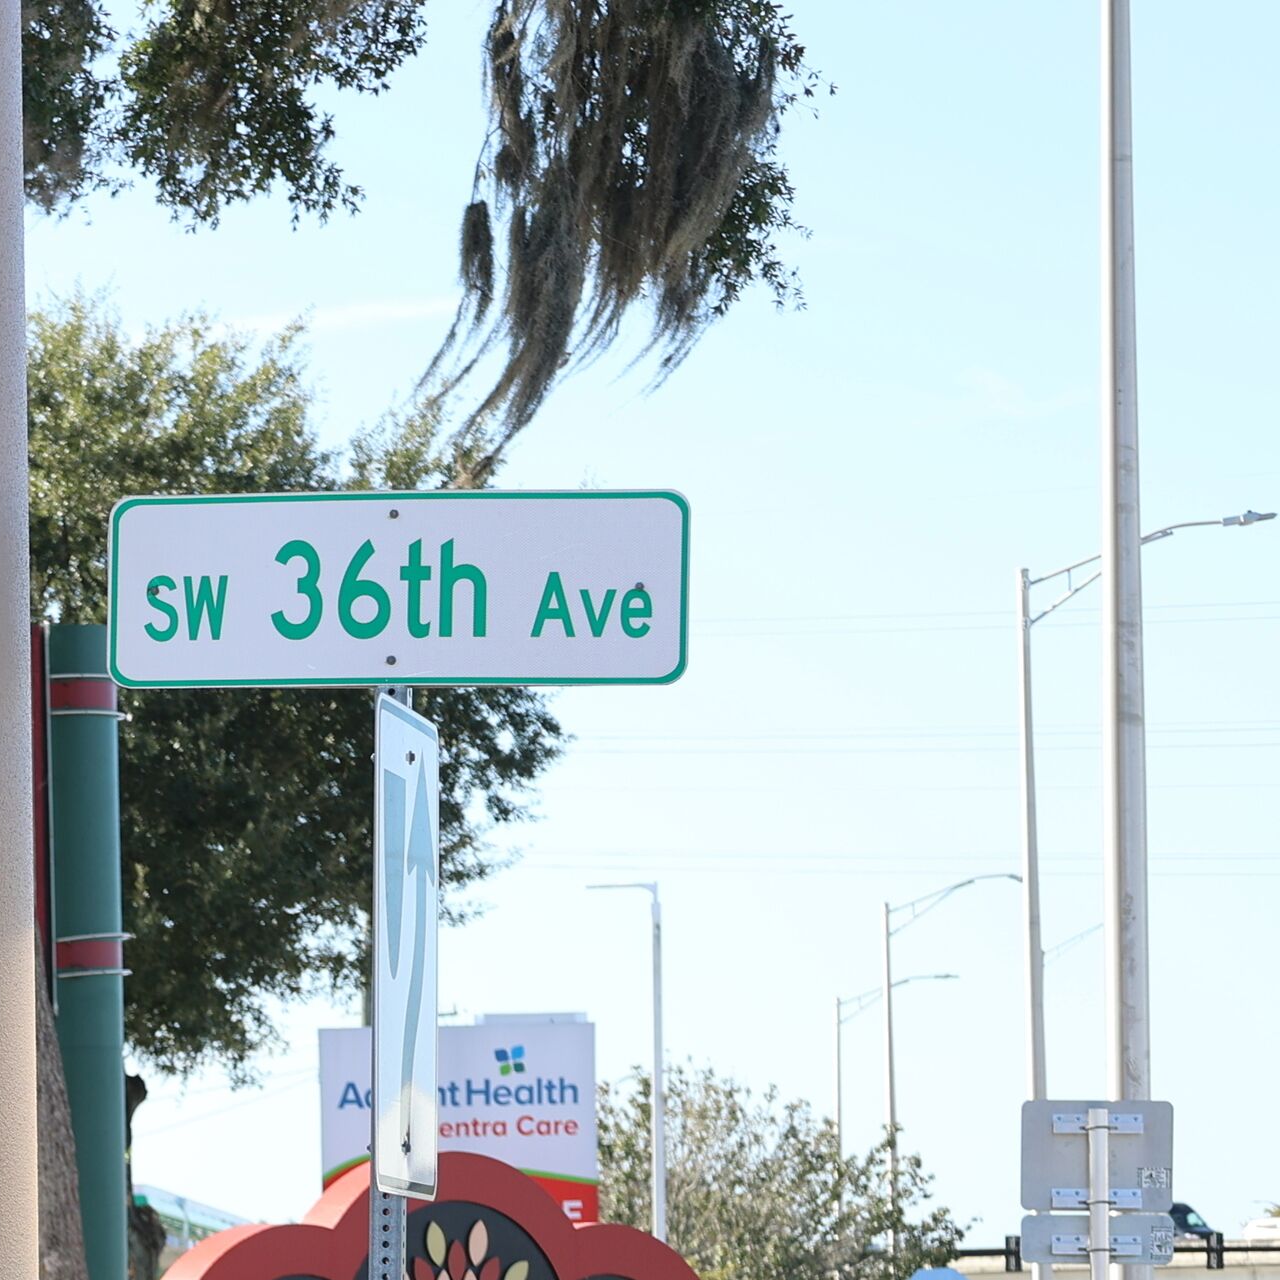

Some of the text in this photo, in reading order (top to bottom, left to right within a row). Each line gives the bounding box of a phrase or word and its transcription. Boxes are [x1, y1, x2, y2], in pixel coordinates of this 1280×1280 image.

[143, 538, 654, 643] SW 36th Ave
[338, 1077, 579, 1109] AtHealth
[439, 1115, 578, 1138] entra Care
